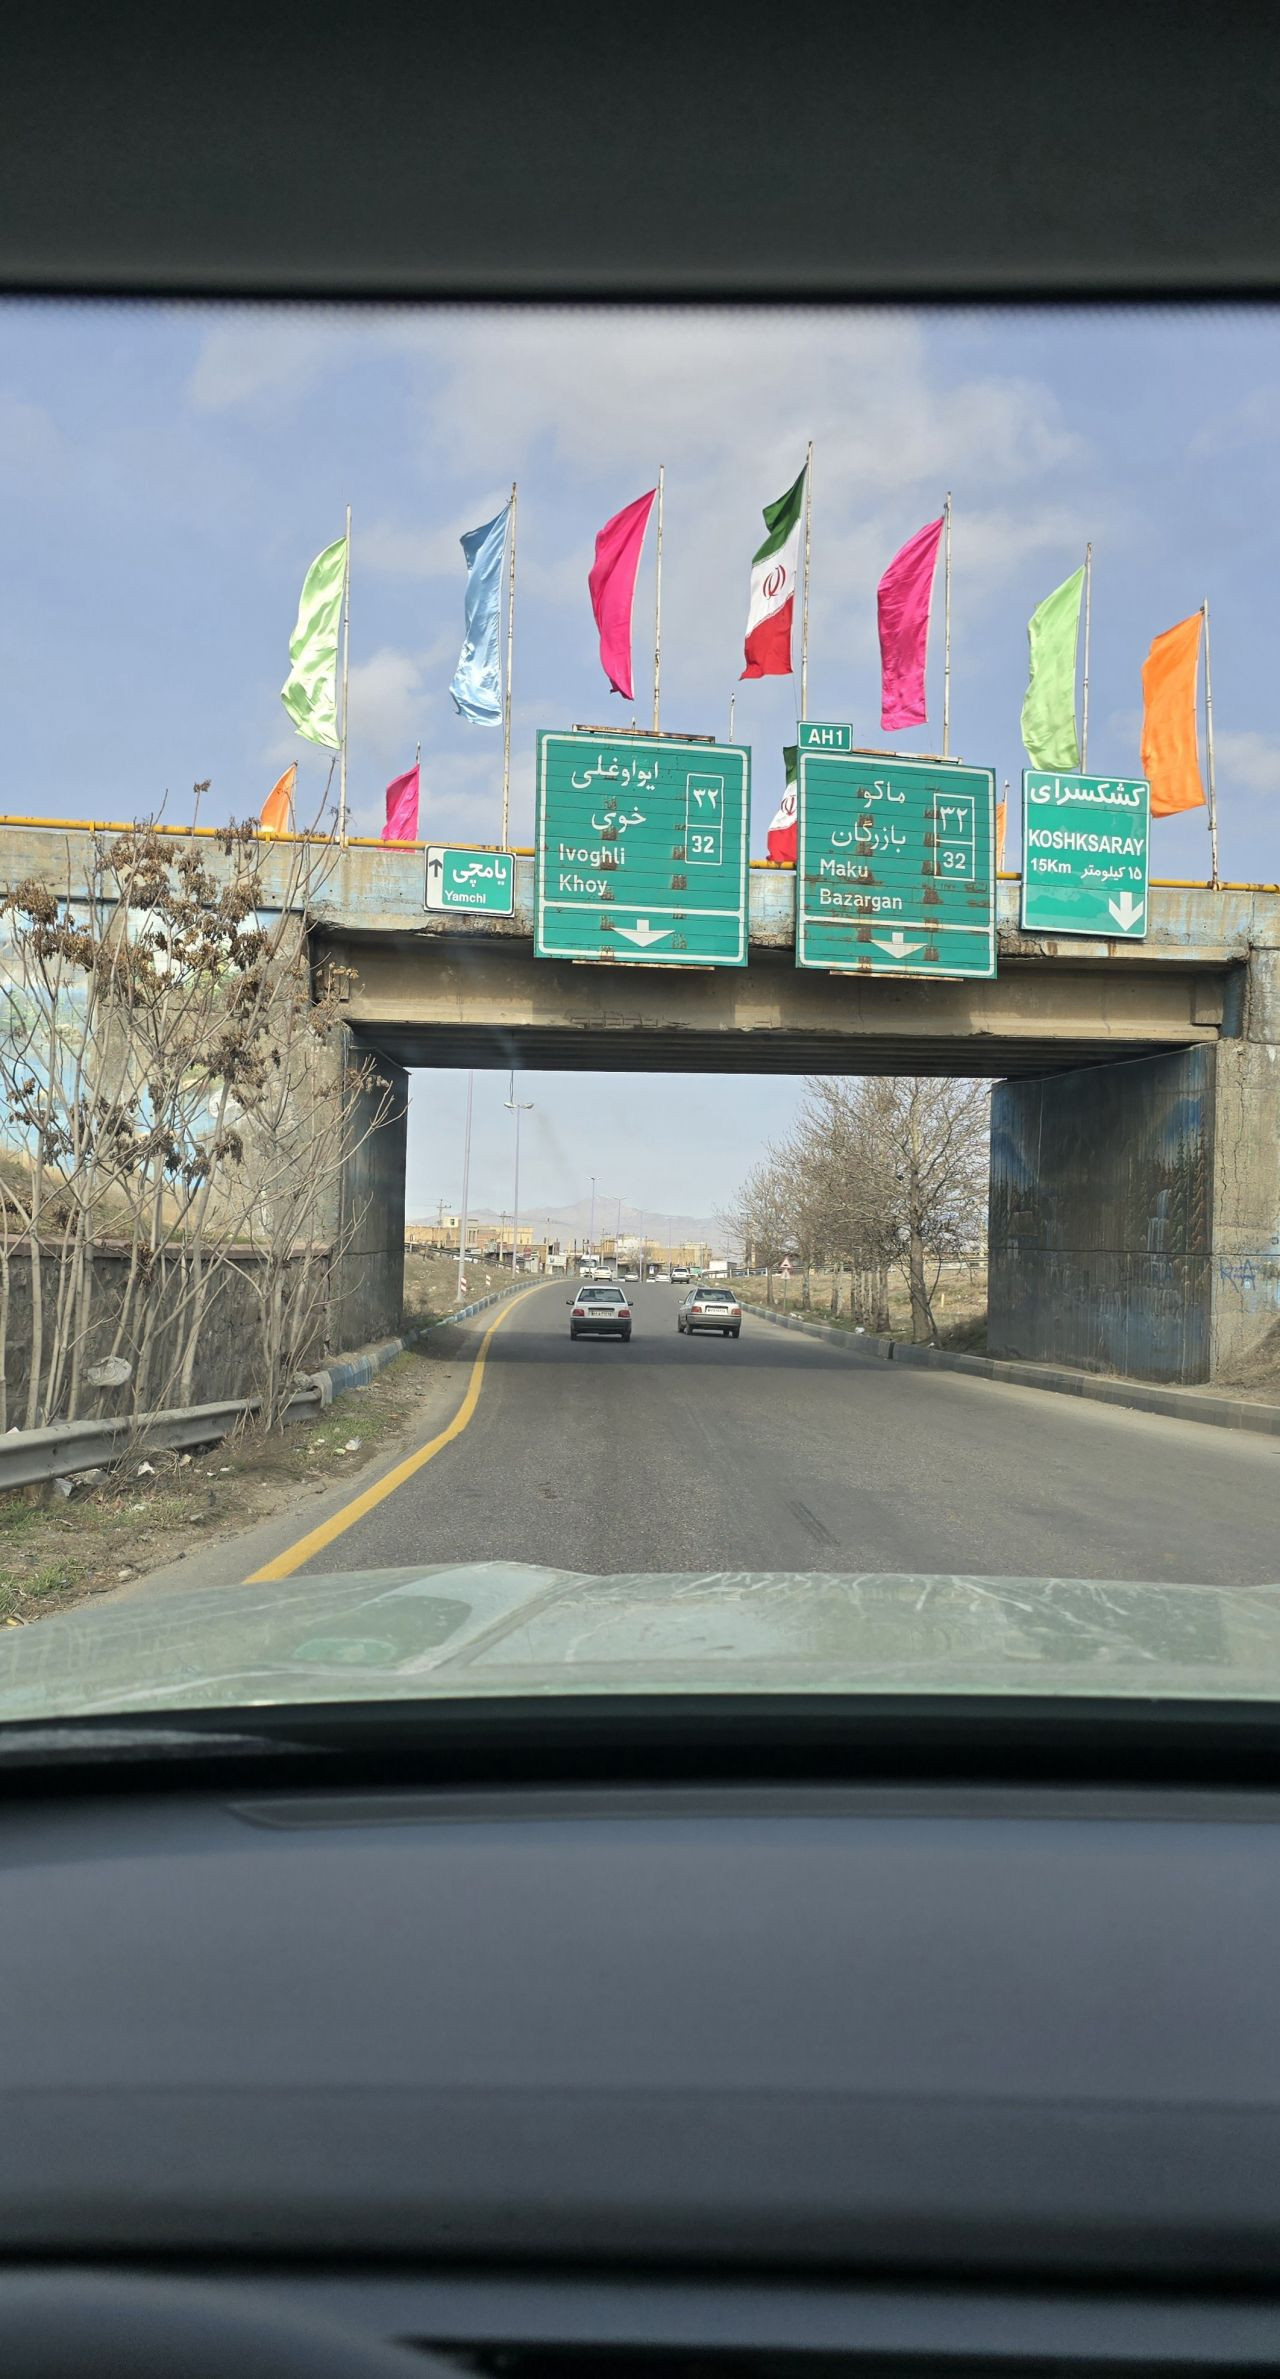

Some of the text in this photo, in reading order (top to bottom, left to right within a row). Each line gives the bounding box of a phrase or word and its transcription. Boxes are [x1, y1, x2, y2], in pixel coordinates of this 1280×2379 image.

[808, 728, 843, 745] AH1
[571, 754, 659, 791] ایواوغلی
[863, 780, 906, 808] ماکو
[1030, 778, 1145, 807] کشکسرای
[591, 806, 647, 833] خوی
[939, 805, 968, 833] ۳۲
[691, 835, 714, 854] 32
[831, 821, 906, 853] بازرگان
[1028, 828, 1144, 856] KOSHKSARAY
[558, 843, 626, 867] Ivoghli
[942, 851, 966, 869] 32
[1030, 857, 1072, 874] 15Km
[452, 859, 507, 888] یامچی
[819, 858, 869, 878] Maku
[1080, 864, 1126, 882] کیلومتر
[444, 889, 486, 904] Yamchi
[558, 874, 608, 896] Khoy
[819, 888, 902, 912] Bazargan
